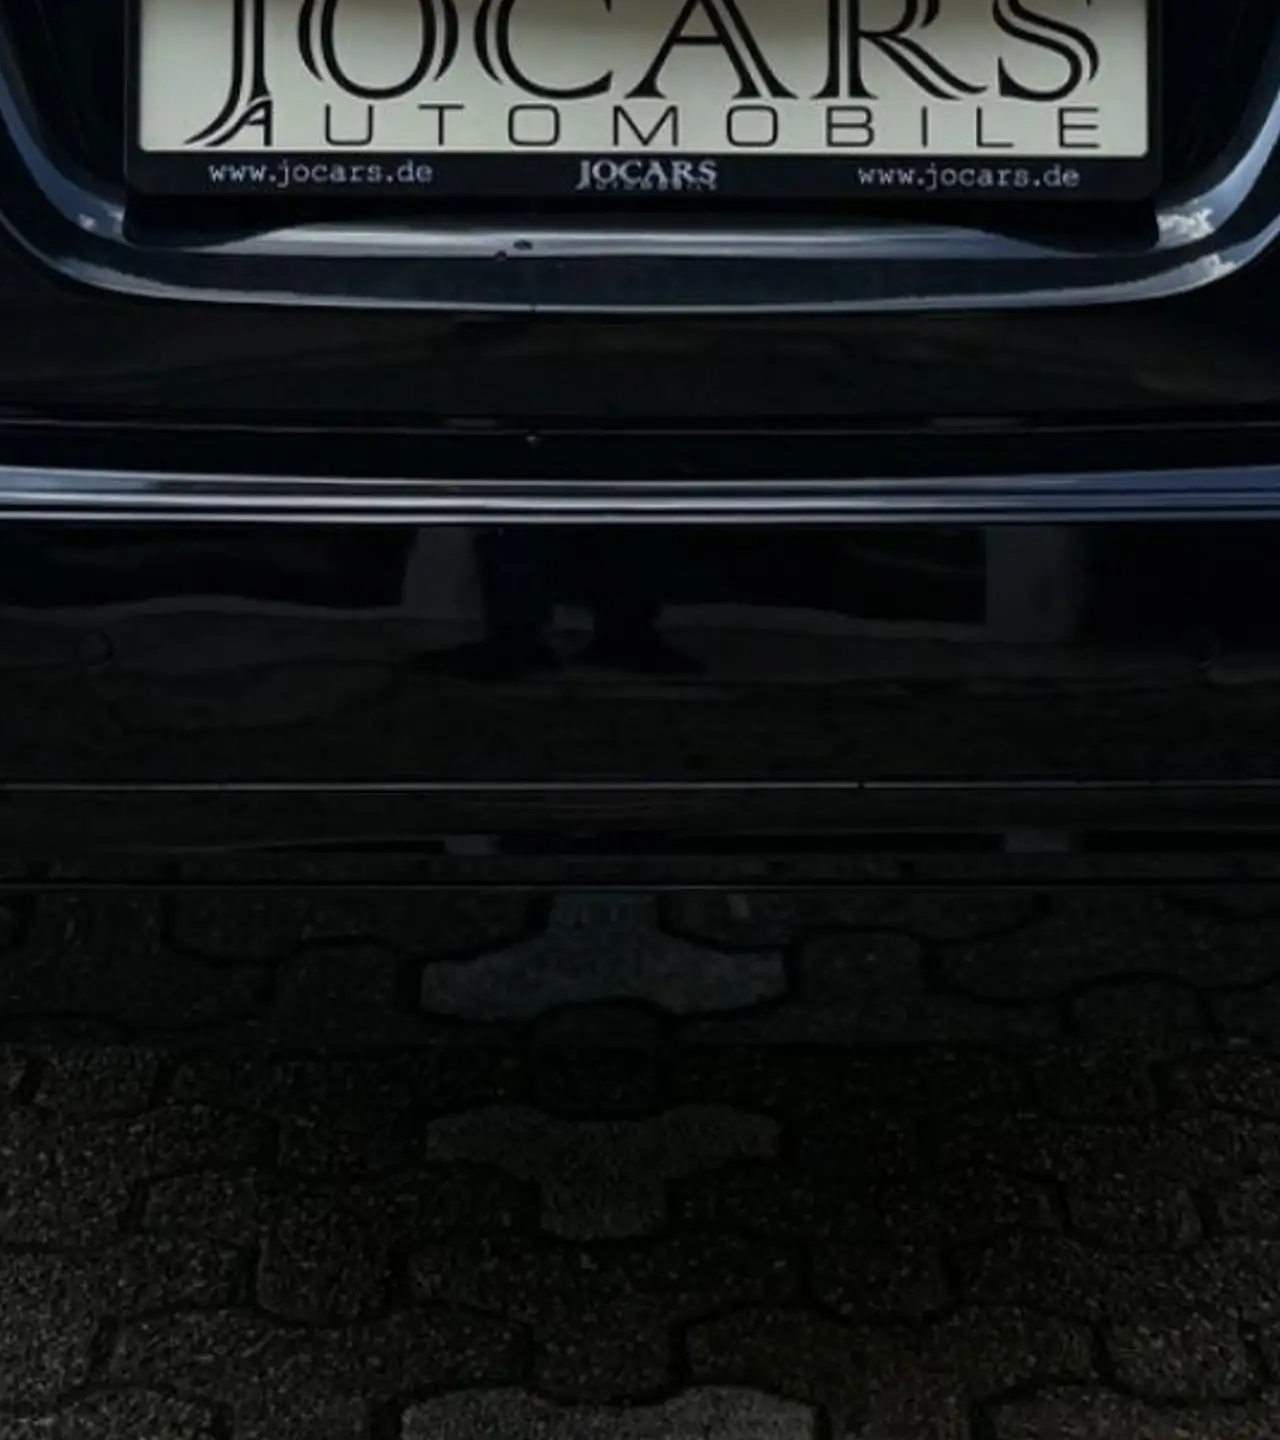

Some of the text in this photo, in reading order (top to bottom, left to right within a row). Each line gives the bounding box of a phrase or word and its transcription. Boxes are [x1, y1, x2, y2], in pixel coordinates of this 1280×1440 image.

[204, 98, 1101, 148] AUTOMOBILE
[208, 159, 432, 188] www.jocars.de
[575, 159, 719, 190] JOCARS
[858, 162, 1081, 191] www.jocars.de
